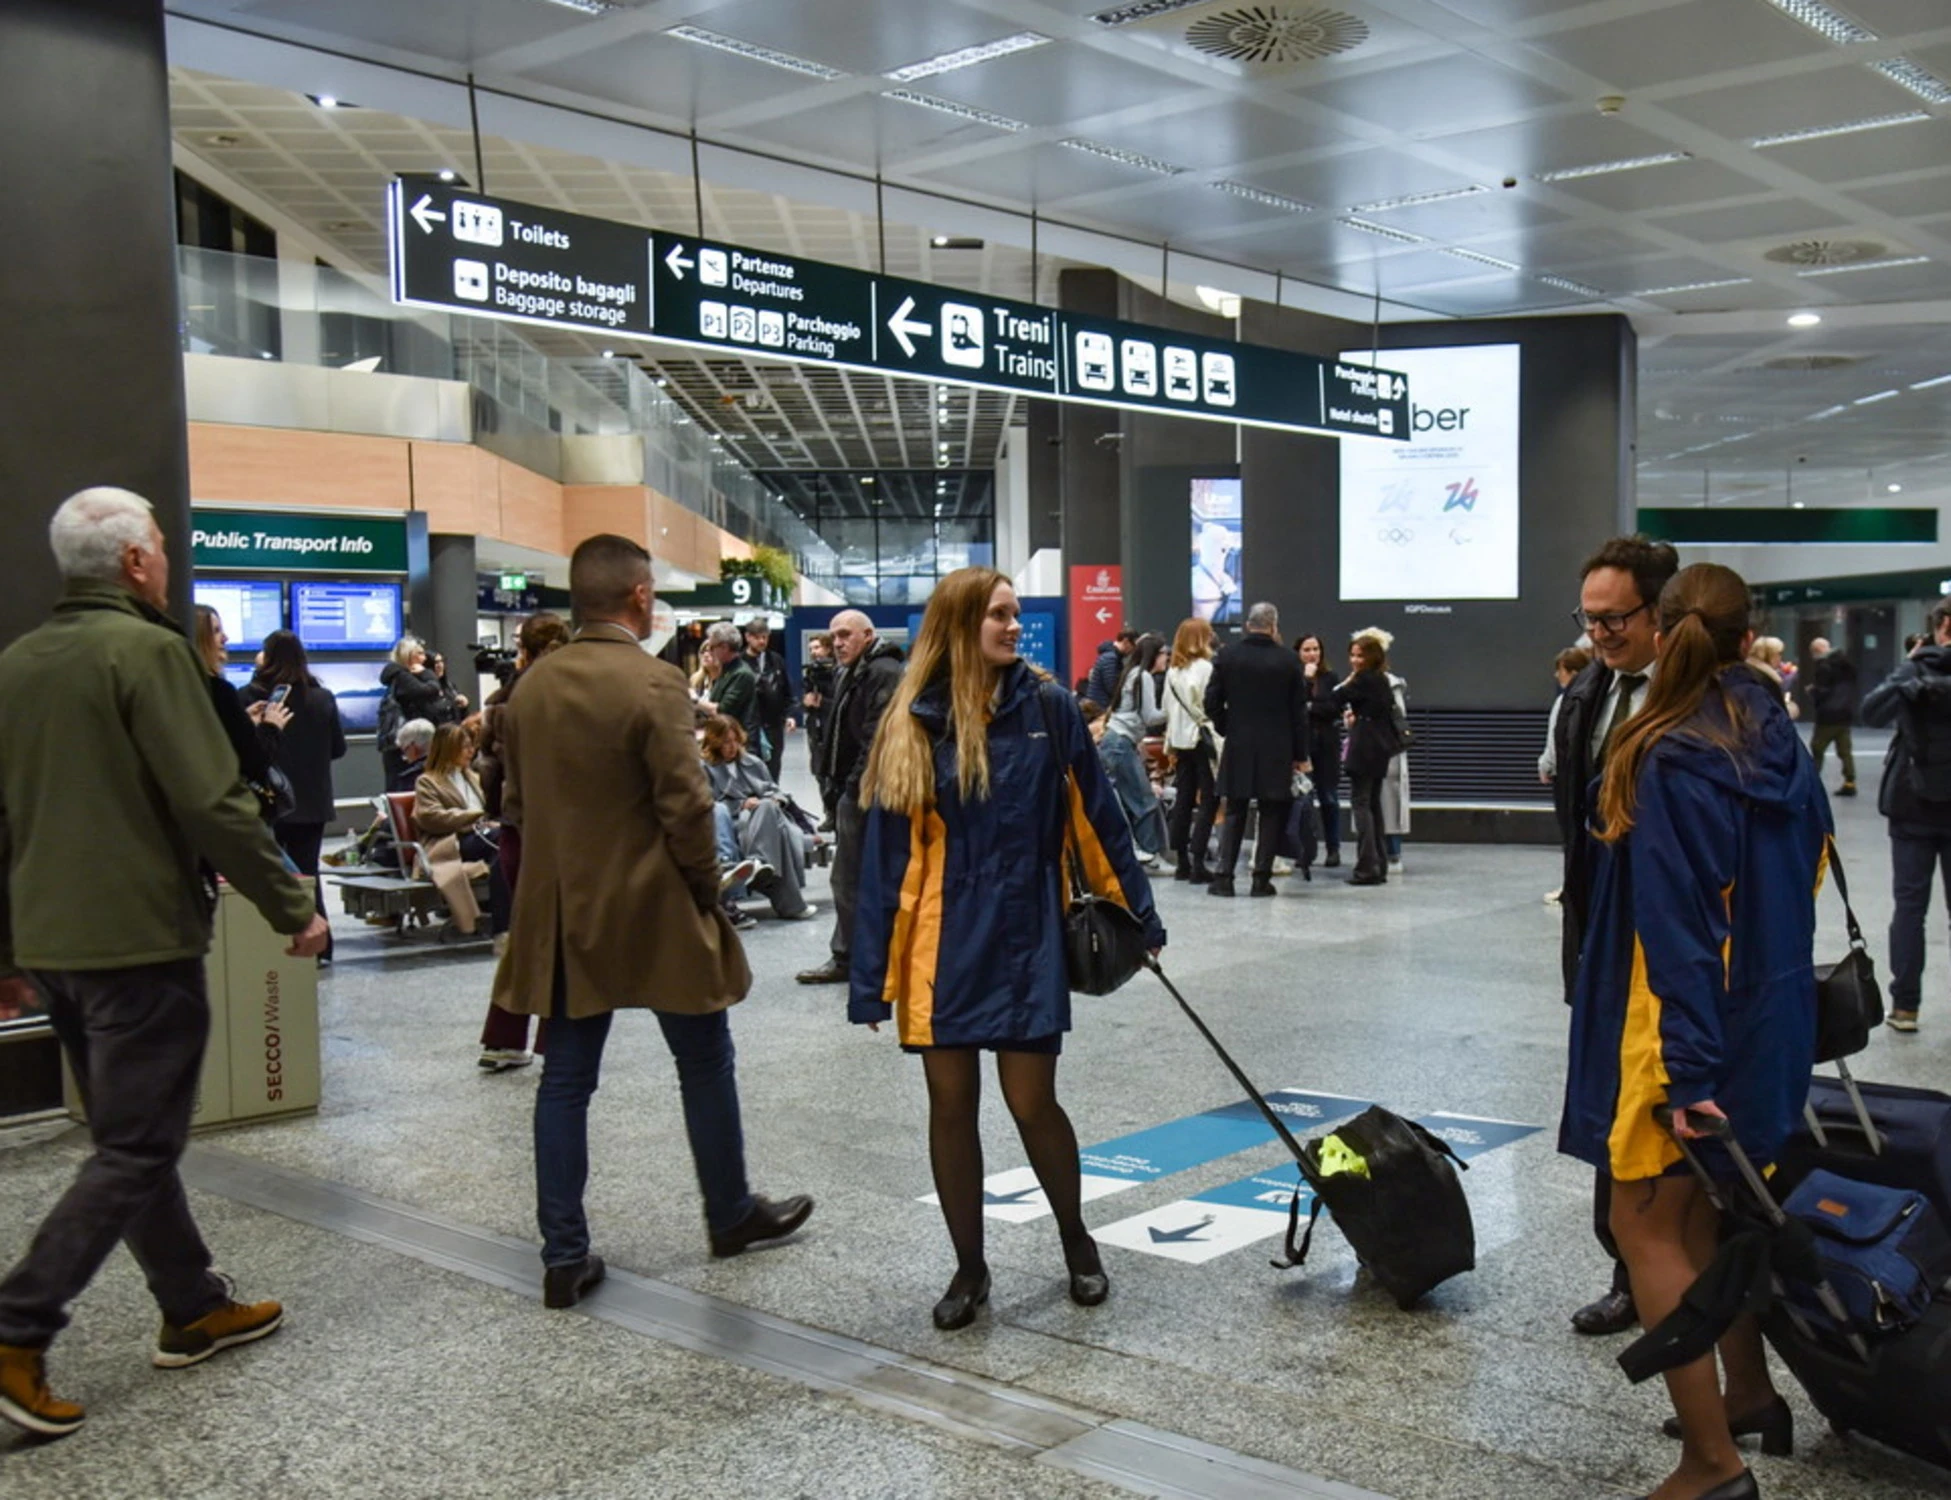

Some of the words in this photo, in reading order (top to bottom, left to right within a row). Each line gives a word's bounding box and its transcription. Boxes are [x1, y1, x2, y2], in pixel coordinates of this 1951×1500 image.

[509, 220, 570, 249] Toilets
[732, 252, 794, 279] Partenze
[495, 262, 572, 293] Deposito
[576, 275, 636, 306] bagagli
[732, 273, 804, 301] Departures
[495, 286, 565, 317] Baggage
[569, 300, 626, 327] storage
[704, 313, 724, 334] P1
[733, 318, 753, 339] P2
[762, 323, 781, 343] P3
[787, 312, 861, 341] Parcheggio
[993, 307, 1050, 344] Treni
[787, 333, 835, 359] Parking
[993, 344, 1055, 381] Trains
[1411, 402, 1470, 432] ber
[191, 529, 250, 549] Public
[253, 531, 337, 555] Transport
[340, 536, 373, 554] Info
[732, 579, 751, 604] 9
[264, 970, 283, 1101] SECCO/Waste
